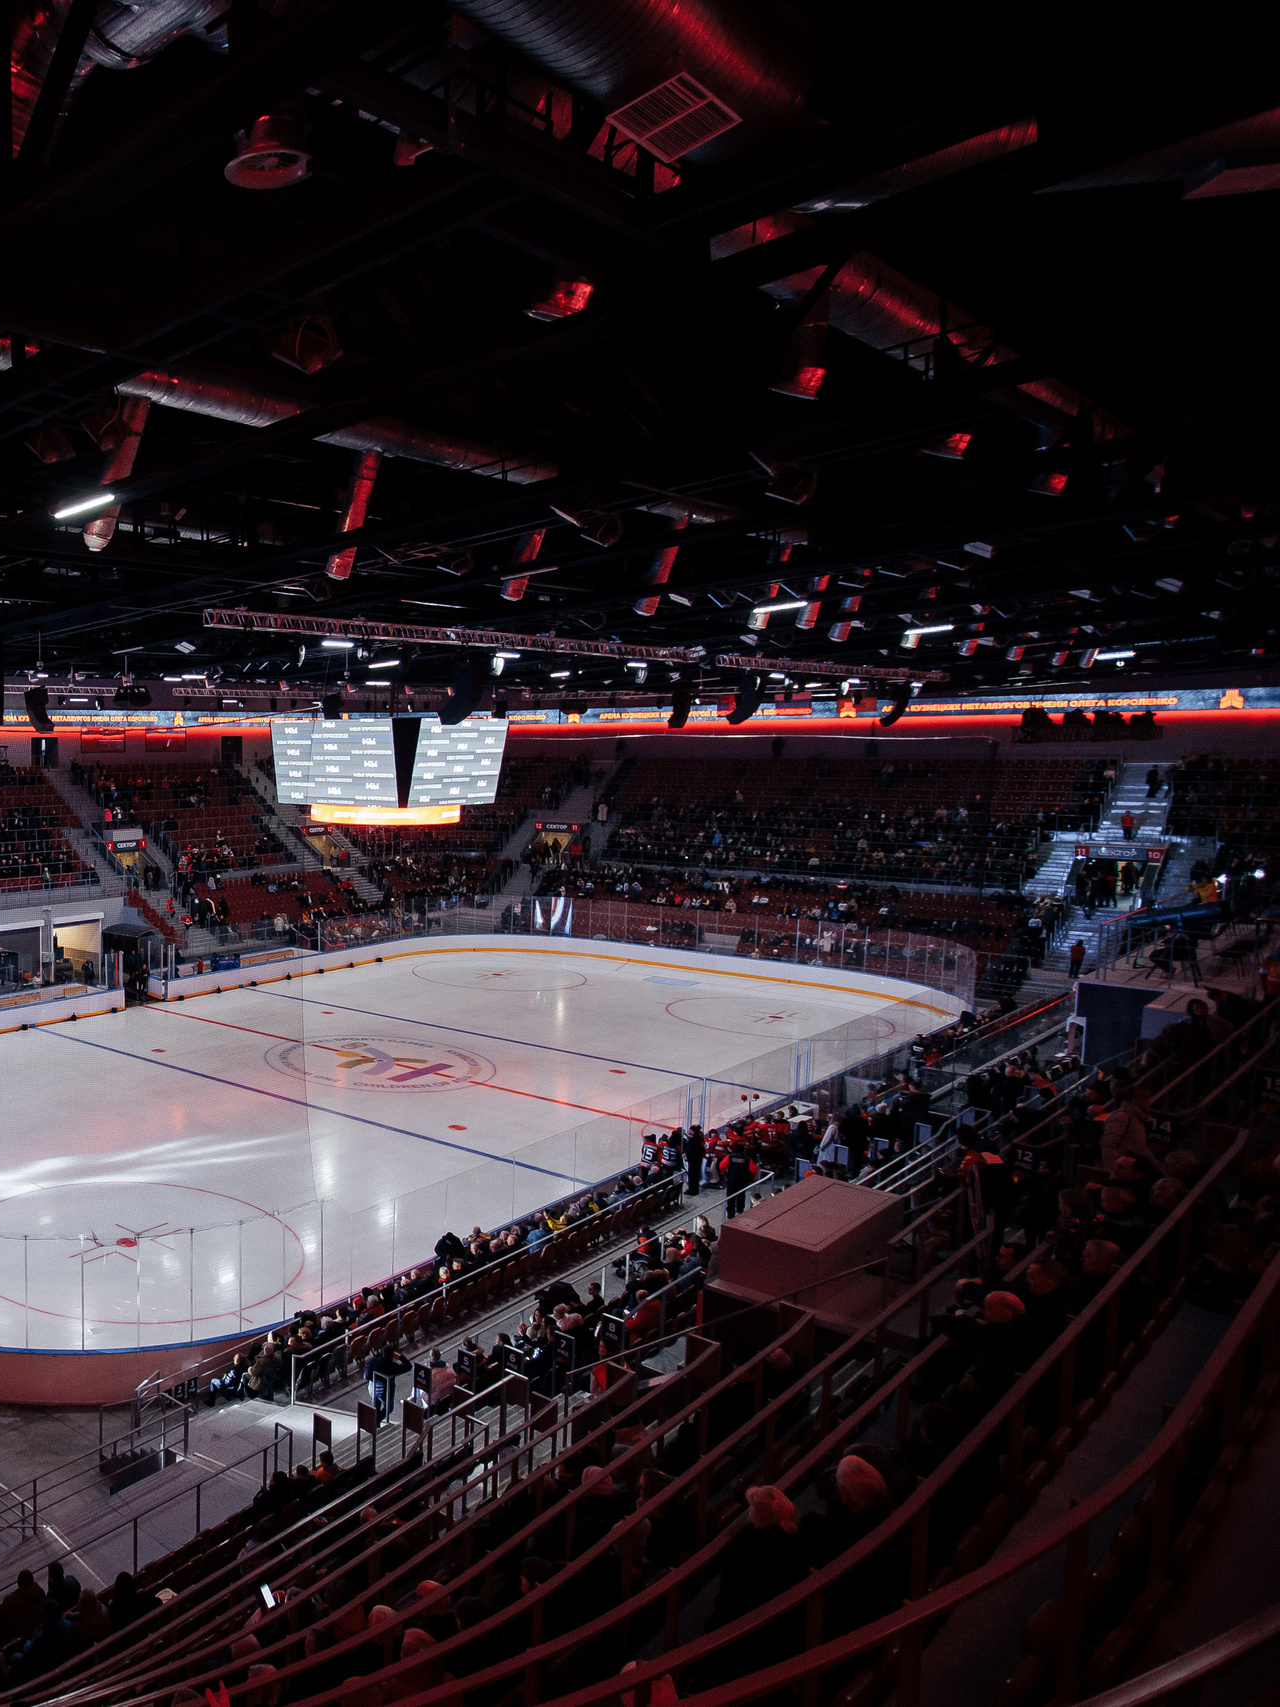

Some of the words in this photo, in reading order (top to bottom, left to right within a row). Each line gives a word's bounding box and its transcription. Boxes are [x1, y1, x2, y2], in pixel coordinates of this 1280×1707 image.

[911, 703, 961, 712] КУЗНЕЦКИХ
[962, 701, 1030, 710] МЕТАЛЛУРГОВ
[1069, 699, 1106, 707] ОЛЕГА
[1107, 696, 1179, 707] КОРОЛЕНКО
[622, 711, 660, 719] КУЗНЕЦКИХ
[1098, 849, 1138, 857] СЕКТОР
[1148, 851, 1160, 859] 10
[387, 1039, 434, 1048] GAMES
[1148, 1117, 1173, 1133] 14
[1015, 1149, 1033, 1162] 12
[608, 1322, 616, 1333] 8
[560, 1339, 567, 1348] 7
[463, 1356, 470, 1365] 5
[509, 1353, 516, 1363] 6
[418, 1369, 425, 1378] 4
